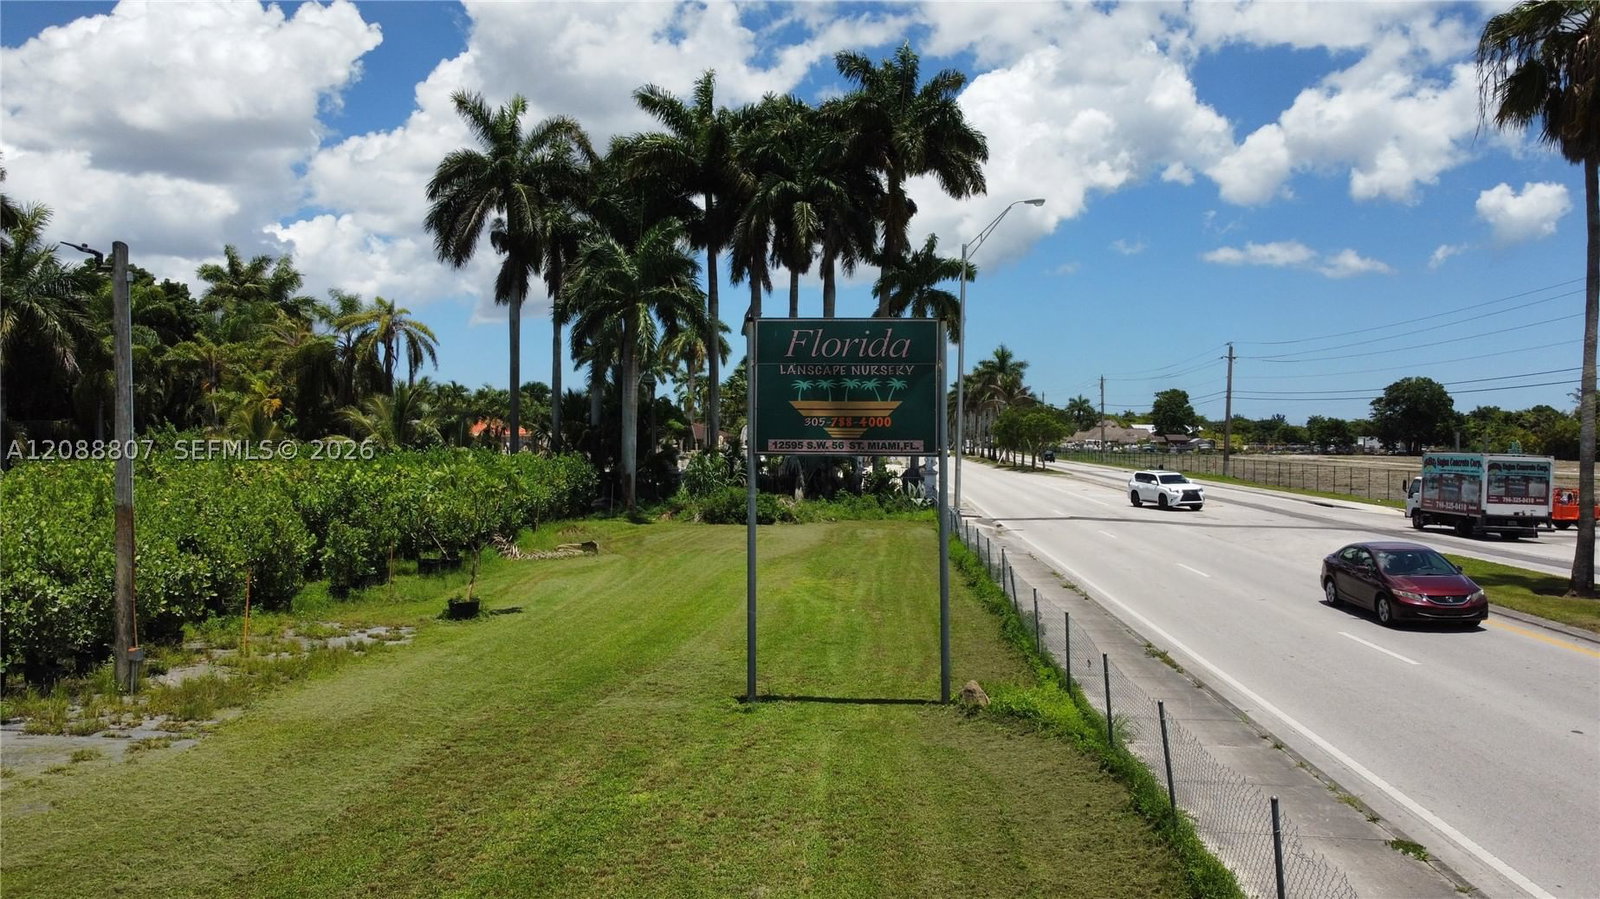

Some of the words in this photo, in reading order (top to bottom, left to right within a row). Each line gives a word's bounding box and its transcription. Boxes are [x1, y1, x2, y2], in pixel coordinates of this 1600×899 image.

[784, 328, 911, 358] Florida
[779, 364, 846, 375] LANSCAPE
[851, 365, 915, 375] NURSERY
[773, 440, 802, 449] 12595
[806, 440, 829, 449] S.W.
[832, 440, 845, 449] 56
[849, 440, 865, 449] ST.
